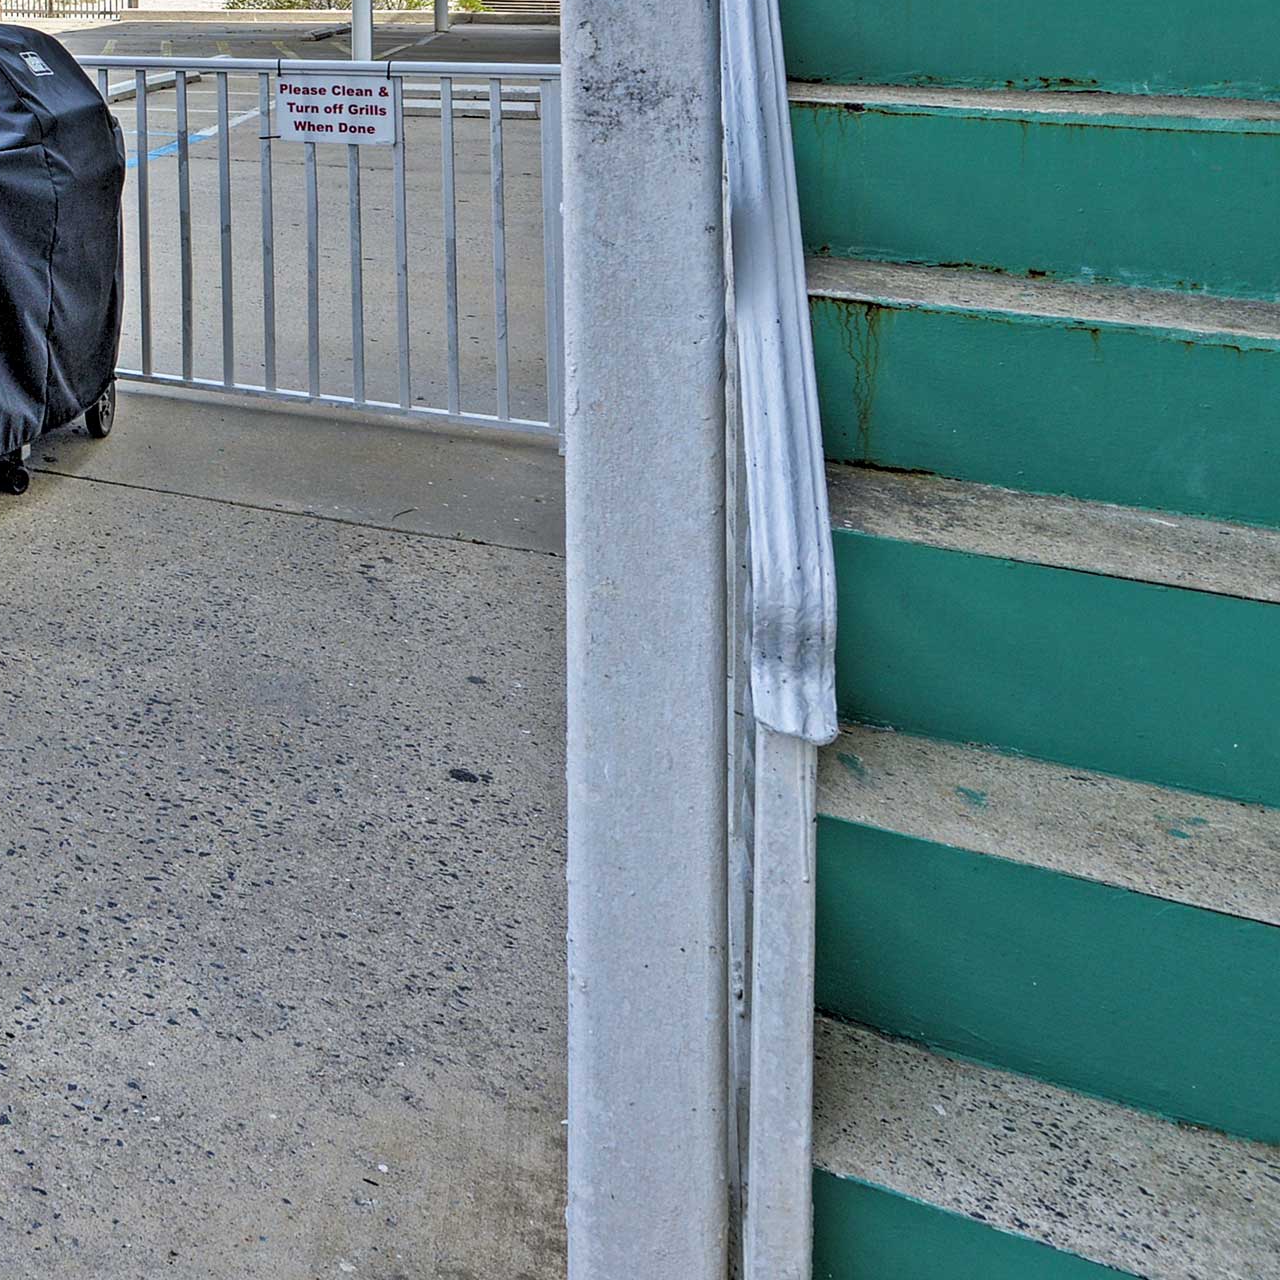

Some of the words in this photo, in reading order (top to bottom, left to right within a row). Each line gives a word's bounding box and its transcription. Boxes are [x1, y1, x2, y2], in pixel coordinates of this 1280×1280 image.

[279, 83, 327, 96] Please
[331, 85, 373, 98] Clean
[378, 86, 389, 98] &
[287, 102, 319, 114] Turn
[323, 103, 344, 115] off
[348, 104, 387, 117] Grills
[294, 120, 333, 133] When
[339, 122, 376, 135] Done
